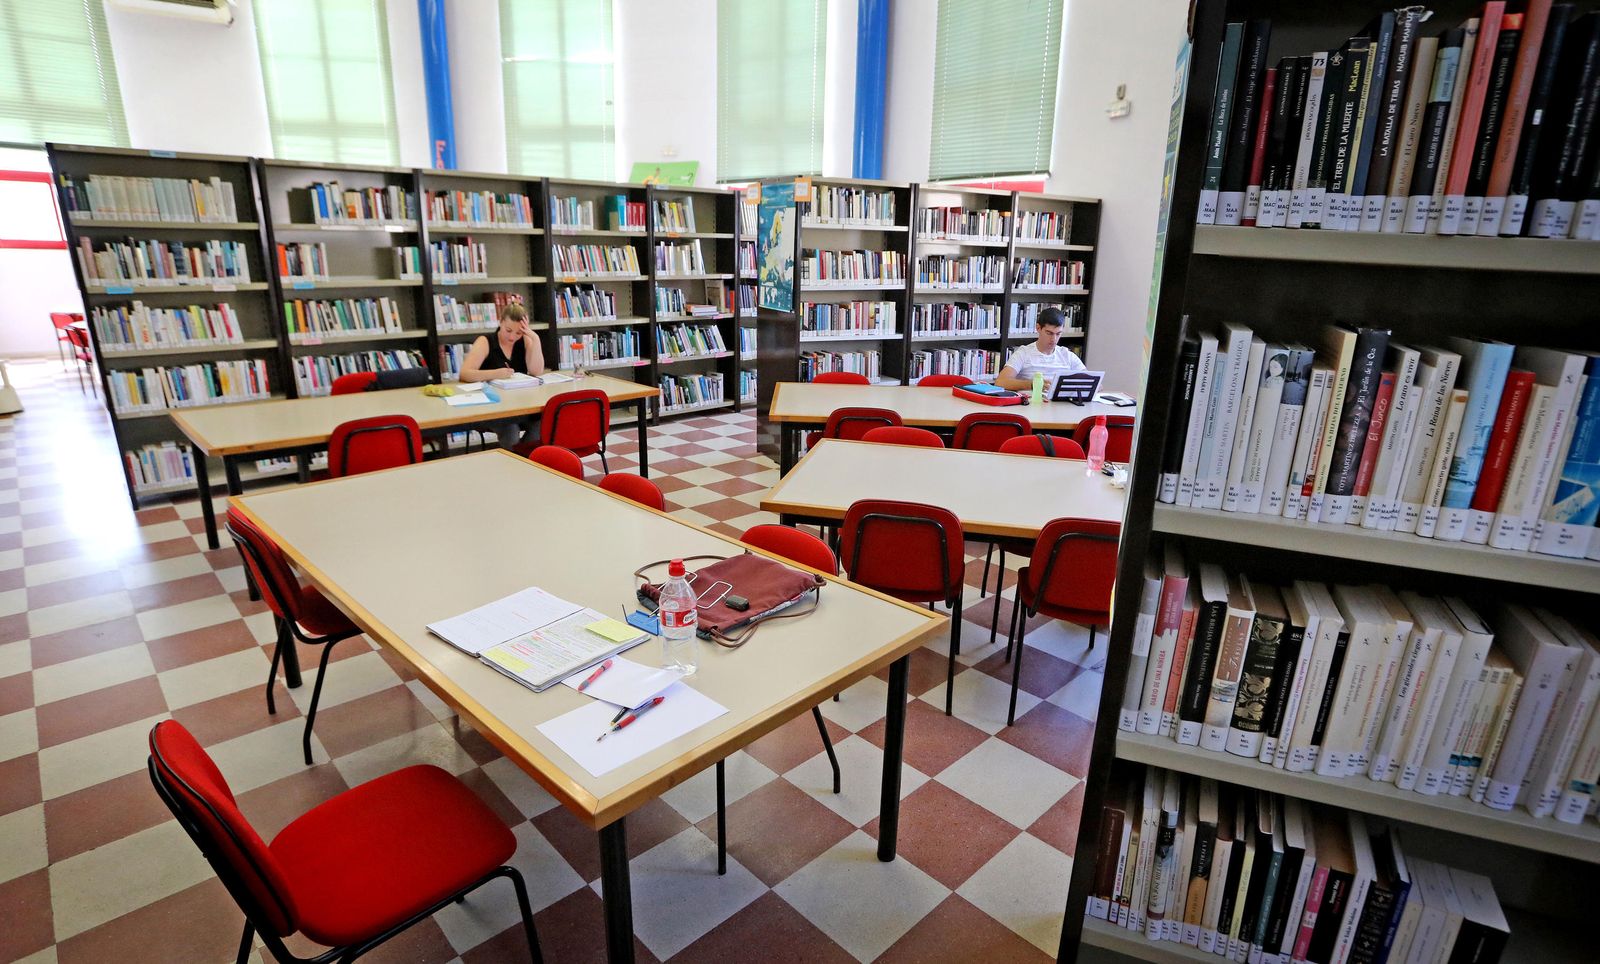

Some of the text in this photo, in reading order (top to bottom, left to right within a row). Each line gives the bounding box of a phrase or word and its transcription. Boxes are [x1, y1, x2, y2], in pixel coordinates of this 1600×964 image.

[1395, 43, 1408, 72] NAGUIB
[1389, 79, 1401, 103] TEBAS
[1387, 102, 1396, 113] DE
[1331, 59, 1362, 190] EL TREN DE LA MUERTE MacLean
[1381, 114, 1394, 145] BATALLA
[1379, 145, 1388, 157] LA
[1363, 367, 1372, 375] de
[1404, 357, 1416, 374] vivir
[1438, 359, 1453, 384] Nieves
[1403, 374, 1411, 384] es
[1223, 371, 1241, 414] BARCELONA
[1398, 384, 1409, 401] raro
[1436, 383, 1446, 395] las
[1395, 400, 1404, 411] Lo
[1434, 395, 1443, 405] de
[1367, 396, 1389, 442] El Junco
[1428, 405, 1441, 426] Reina
[1425, 426, 1434, 437] La
[1325, 435, 1333, 447] LAS
[1197, 604, 1219, 681] LAS BRUJAS DE ESMIRNA
[1153, 669, 1162, 681] UNA
[1398, 637, 1422, 698] Los girasoles ciegos
[1152, 680, 1160, 688] DE
[1148, 687, 1159, 706] DIARIO
